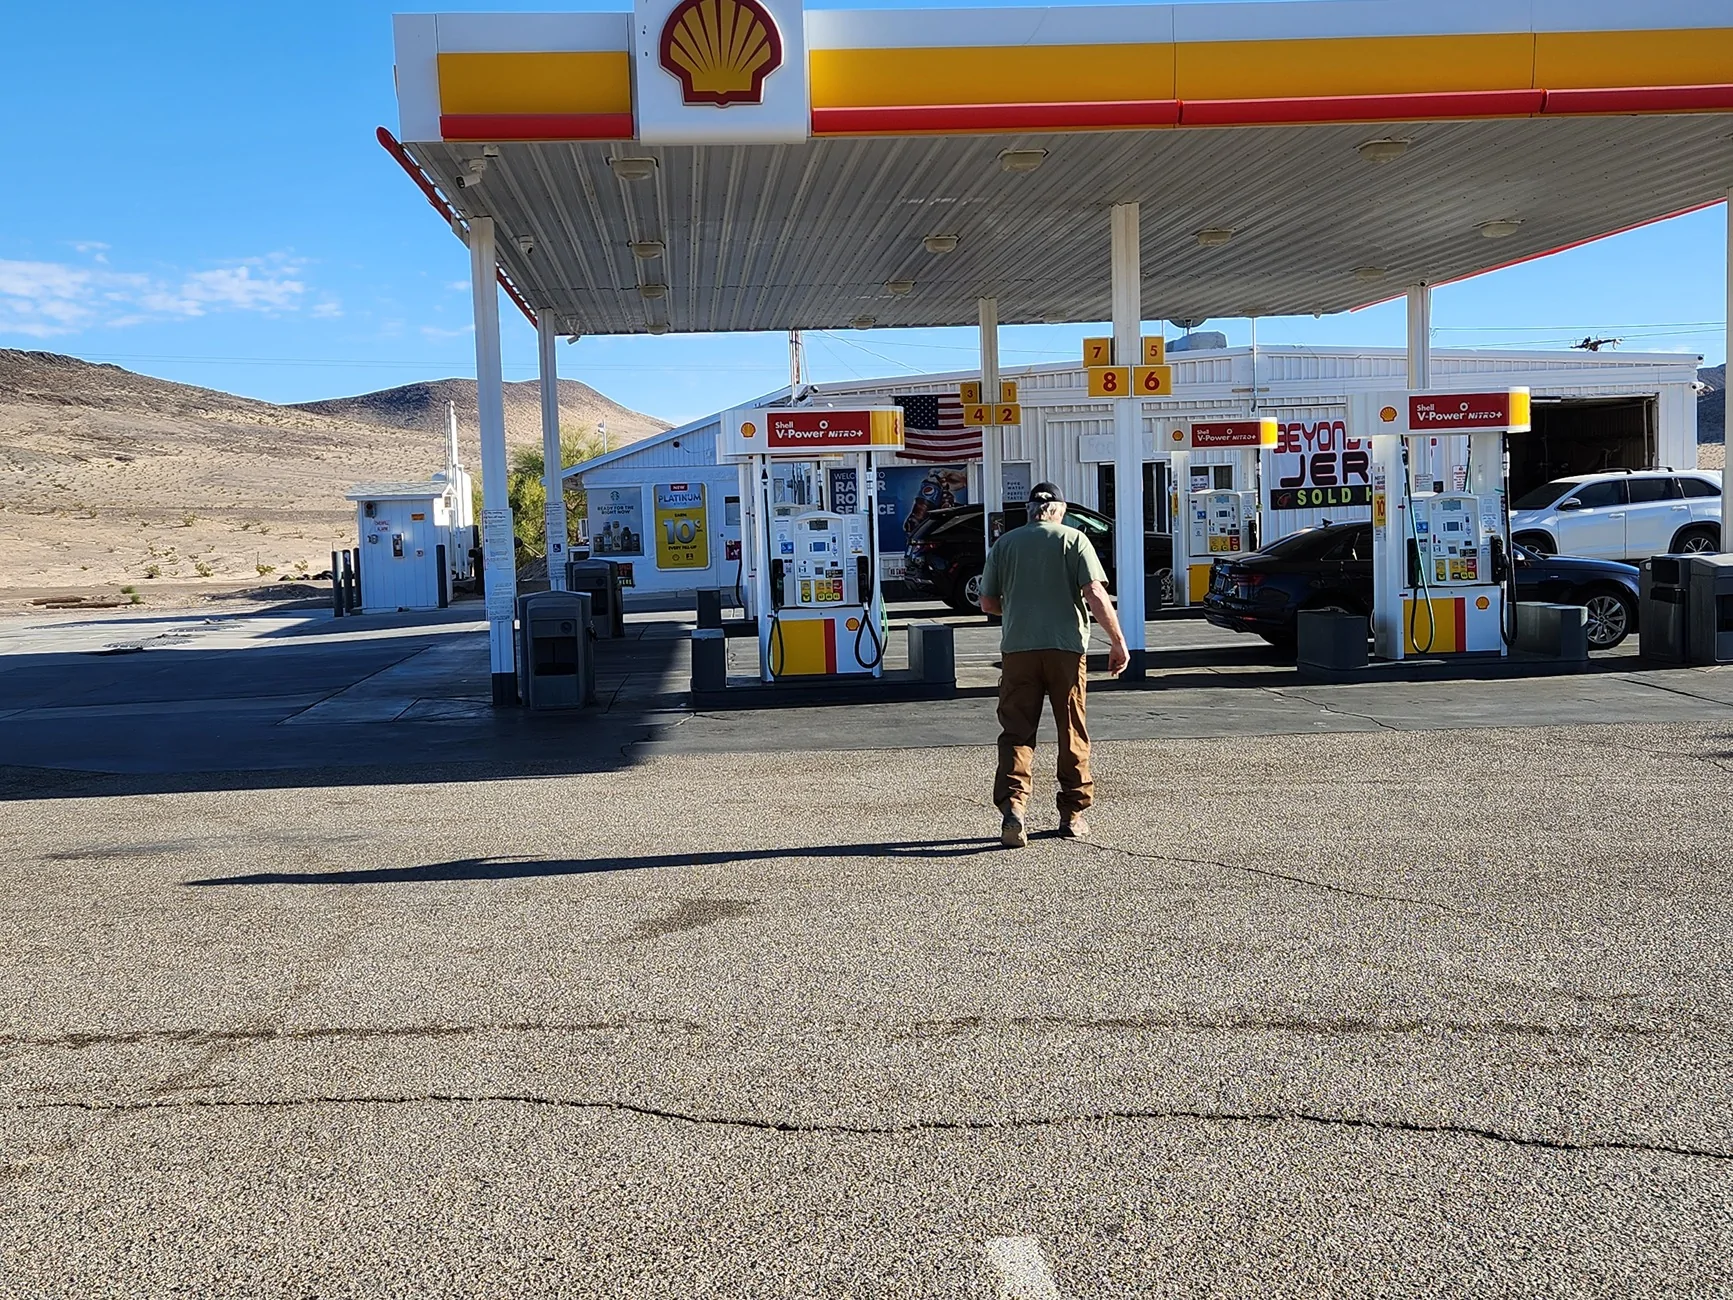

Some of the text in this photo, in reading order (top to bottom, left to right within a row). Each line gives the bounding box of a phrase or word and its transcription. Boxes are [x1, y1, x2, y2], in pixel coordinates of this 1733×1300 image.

[1092, 346, 1102, 358] 7
[1150, 345, 1158, 357] 5
[1102, 371, 1117, 392] 8
[1144, 371, 1160, 391] 6
[967, 389, 974, 398] 3
[1416, 403, 1434, 412] Shell
[973, 408, 984, 422] 4
[1002, 408, 1012, 422] 2
[1417, 411, 1464, 421] V-Power
[775, 421, 794, 429] Shell
[776, 429, 825, 439] V-Power
[658, 493, 702, 503] PLATINUM
[1297, 488, 1352, 506] SOLD
